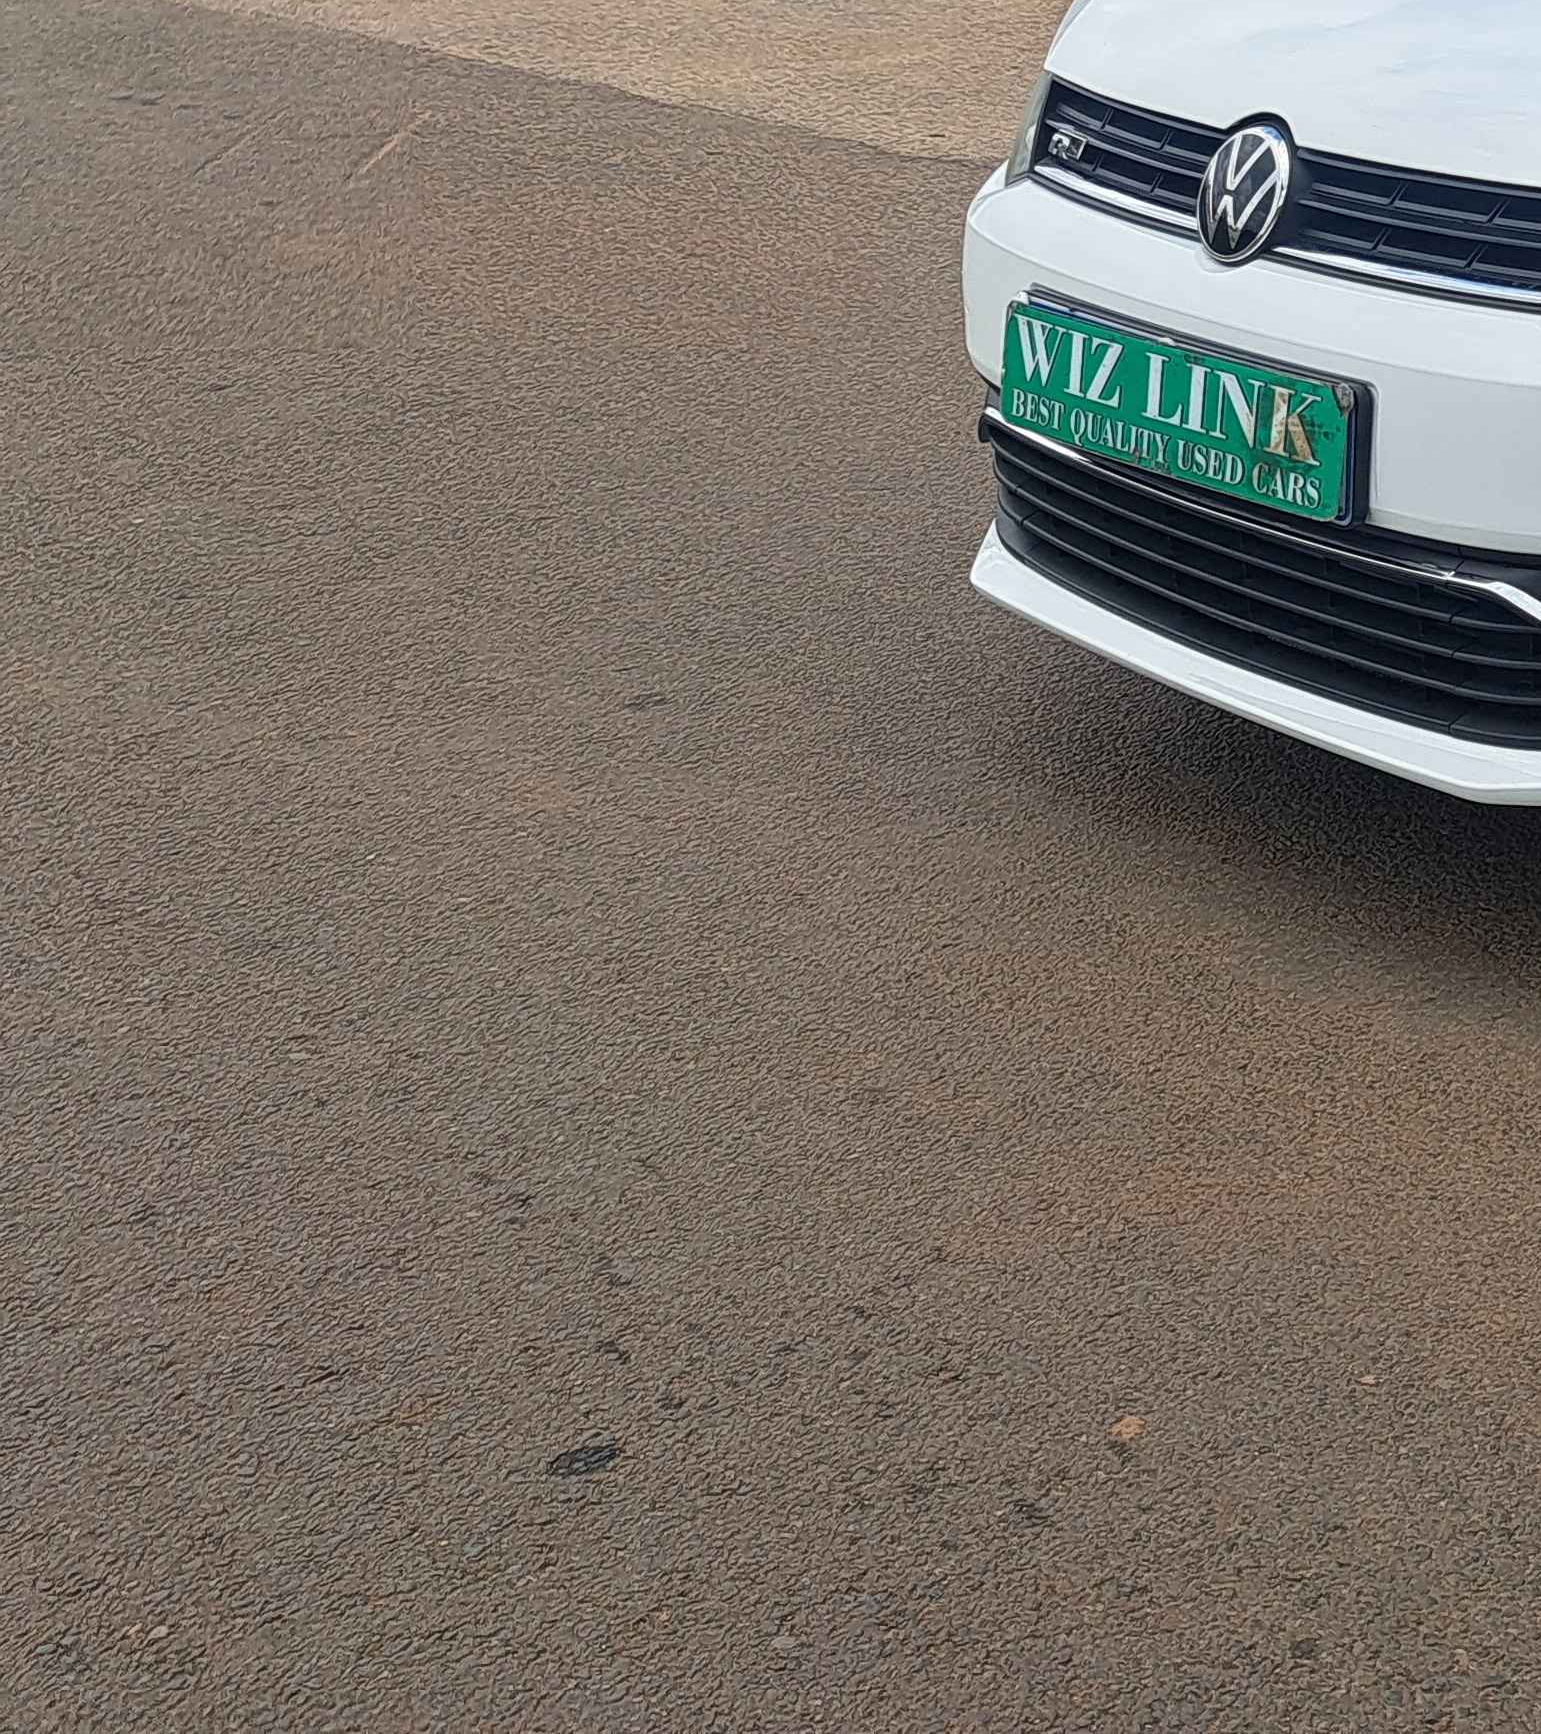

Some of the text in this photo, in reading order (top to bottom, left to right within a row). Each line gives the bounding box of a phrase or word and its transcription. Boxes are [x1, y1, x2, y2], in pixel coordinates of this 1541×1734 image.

[1012, 388, 1322, 510] BEST QUALITY USED CARS
[1014, 313, 1323, 466] WIZ LINK
